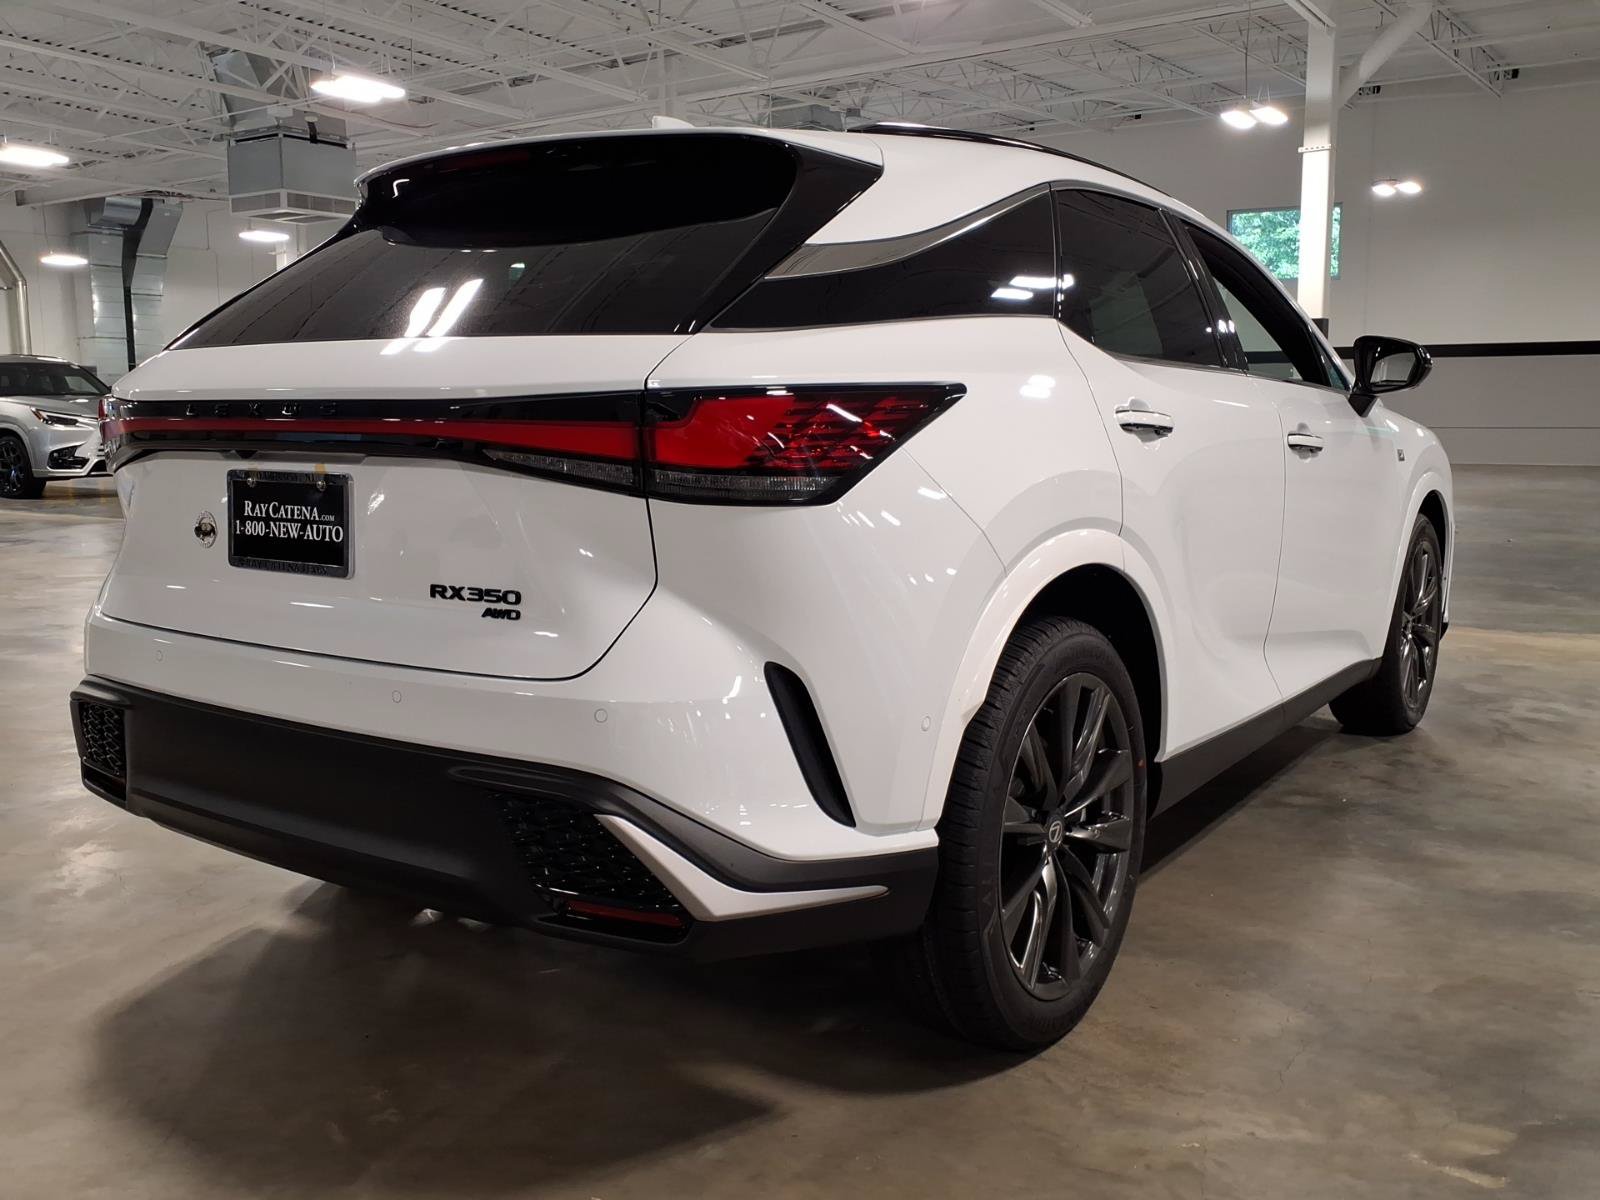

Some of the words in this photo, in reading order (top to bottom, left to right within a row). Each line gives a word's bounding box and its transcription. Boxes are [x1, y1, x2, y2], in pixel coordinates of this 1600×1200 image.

[186, 402, 336, 416] LEXUS
[235, 519, 344, 542] 1-800-NEW-AUTO
[429, 583, 522, 605] RX350
[481, 607, 521, 621] AWD
